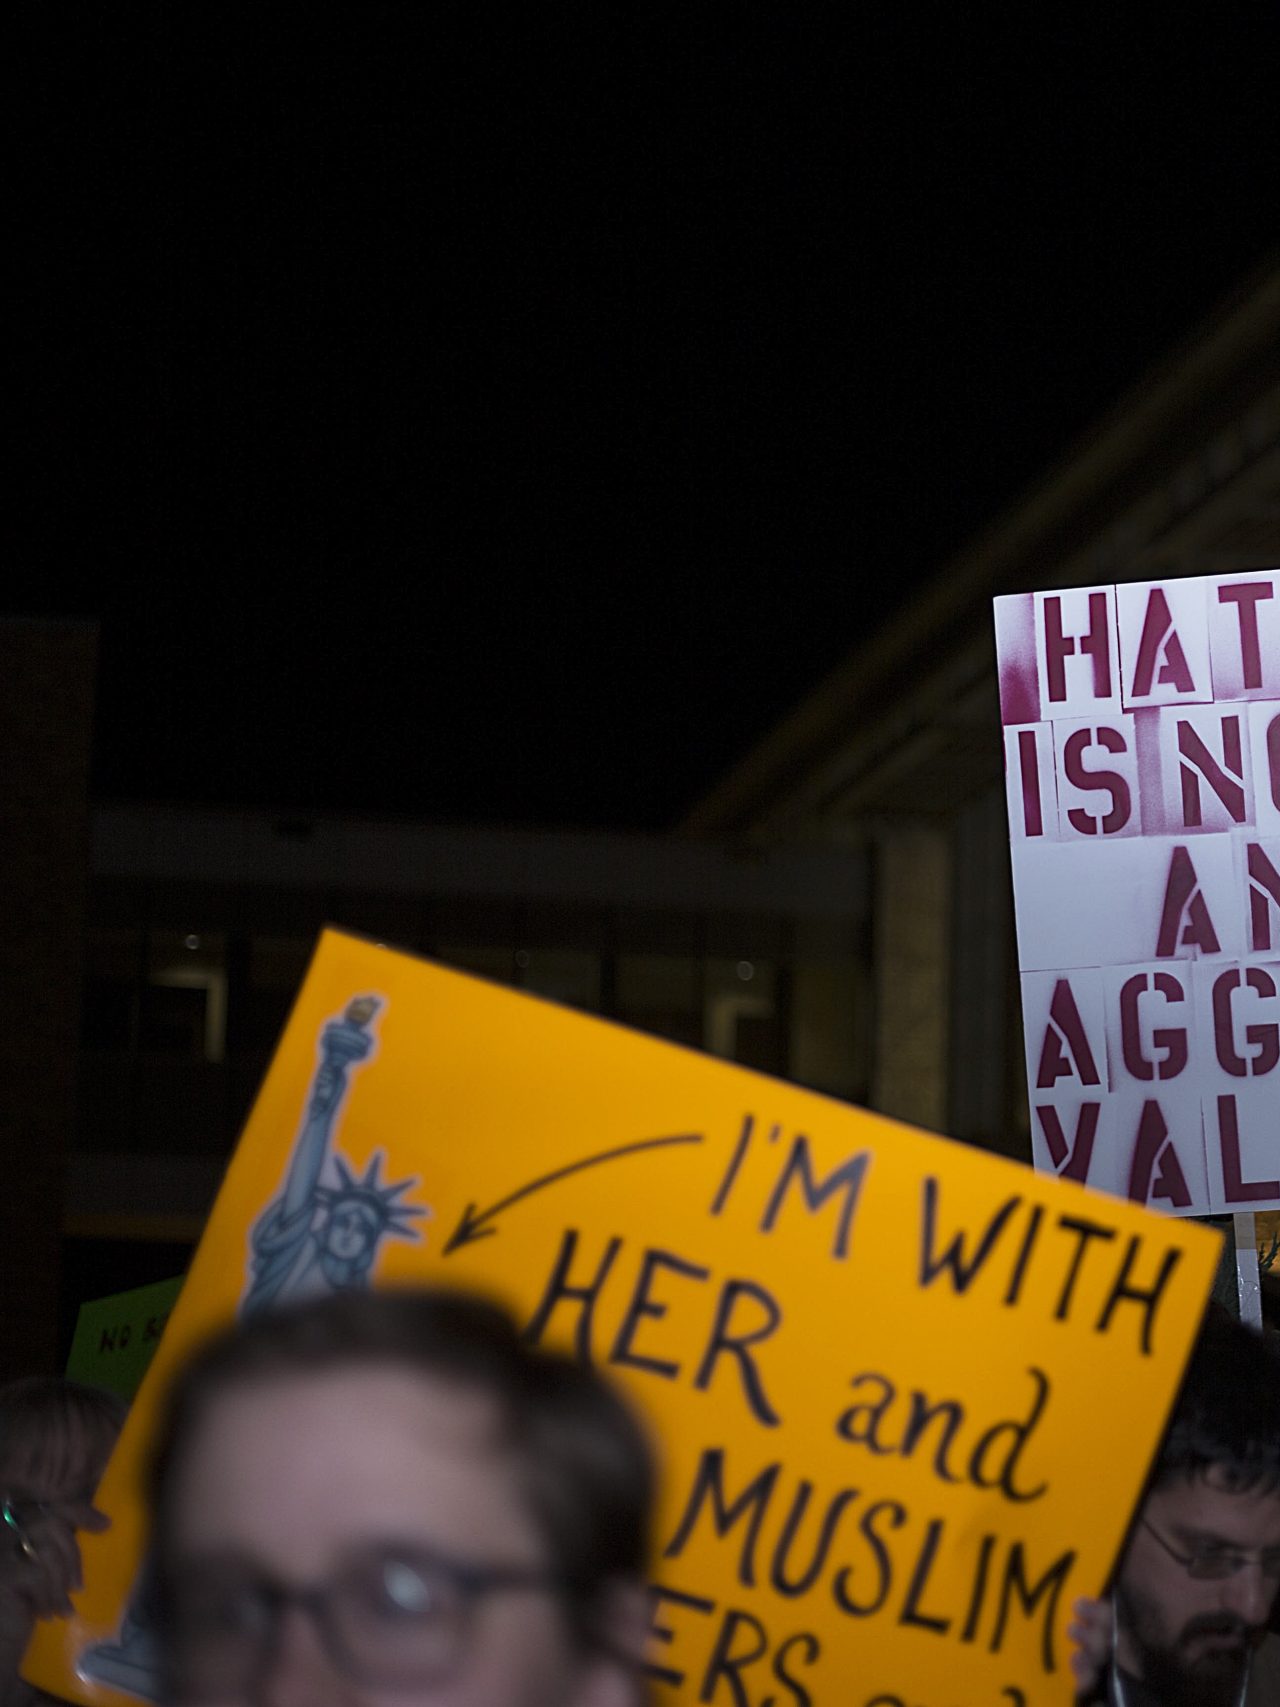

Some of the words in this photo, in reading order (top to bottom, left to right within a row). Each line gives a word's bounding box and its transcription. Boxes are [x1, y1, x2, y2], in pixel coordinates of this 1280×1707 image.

[1018, 725, 1133, 837] IS
[708, 1115, 875, 1261] I'M
[918, 1175, 1184, 1357] WITH
[526, 1226, 782, 1430] HER
[834, 1366, 1050, 1501] and
[642, 1583, 821, 1707] ERS
[663, 1447, 1077, 1675] MUSLIM
